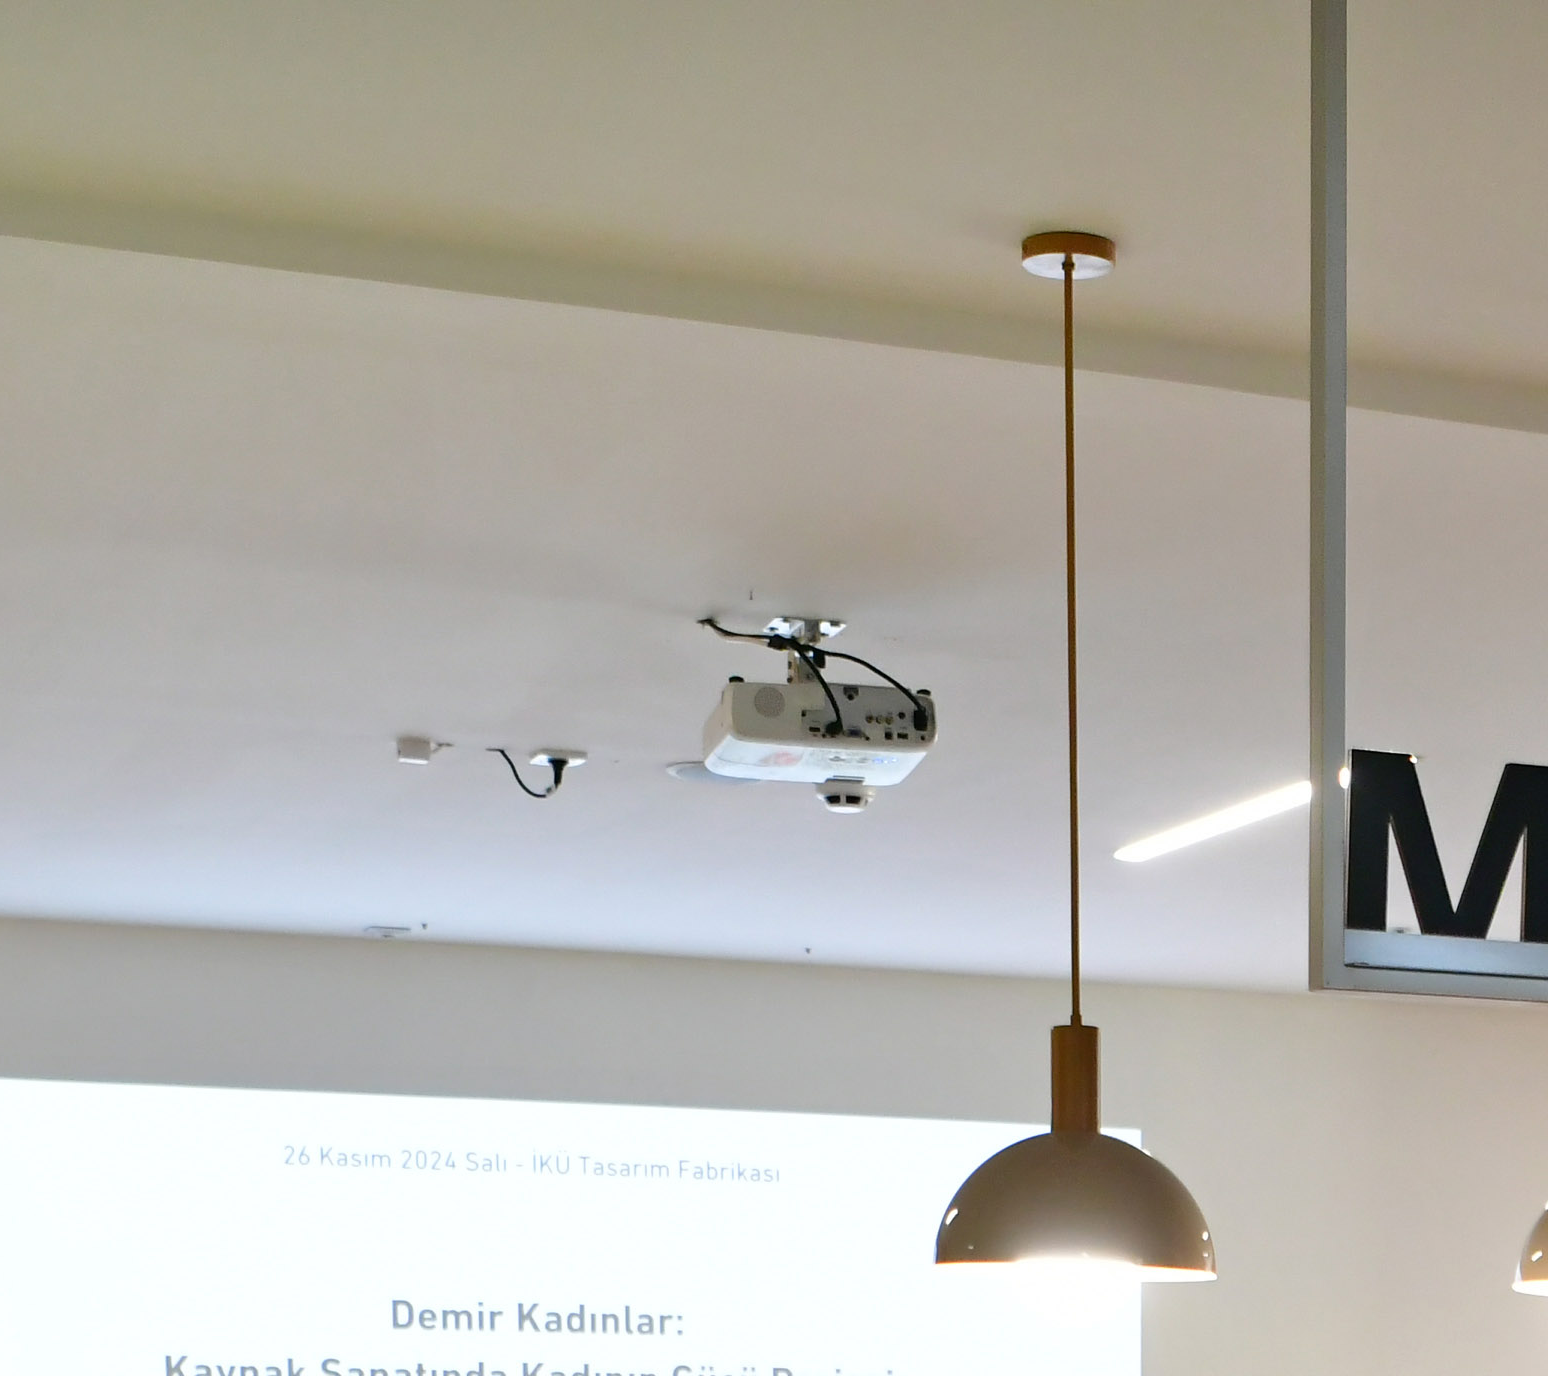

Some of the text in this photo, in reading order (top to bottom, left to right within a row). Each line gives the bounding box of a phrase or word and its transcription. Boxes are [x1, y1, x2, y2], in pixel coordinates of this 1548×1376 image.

[283, 1145, 311, 1166] 26
[320, 1147, 391, 1169] Kasım
[401, 1150, 457, 1171] 2024
[465, 1152, 508, 1173] Salı
[531, 1148, 571, 1175] İKÜ
[577, 1156, 669, 1179] Tasarım
[678, 1159, 781, 1183] Fabrikası
[390, 1299, 684, 1338] Demir Kadınlar:
